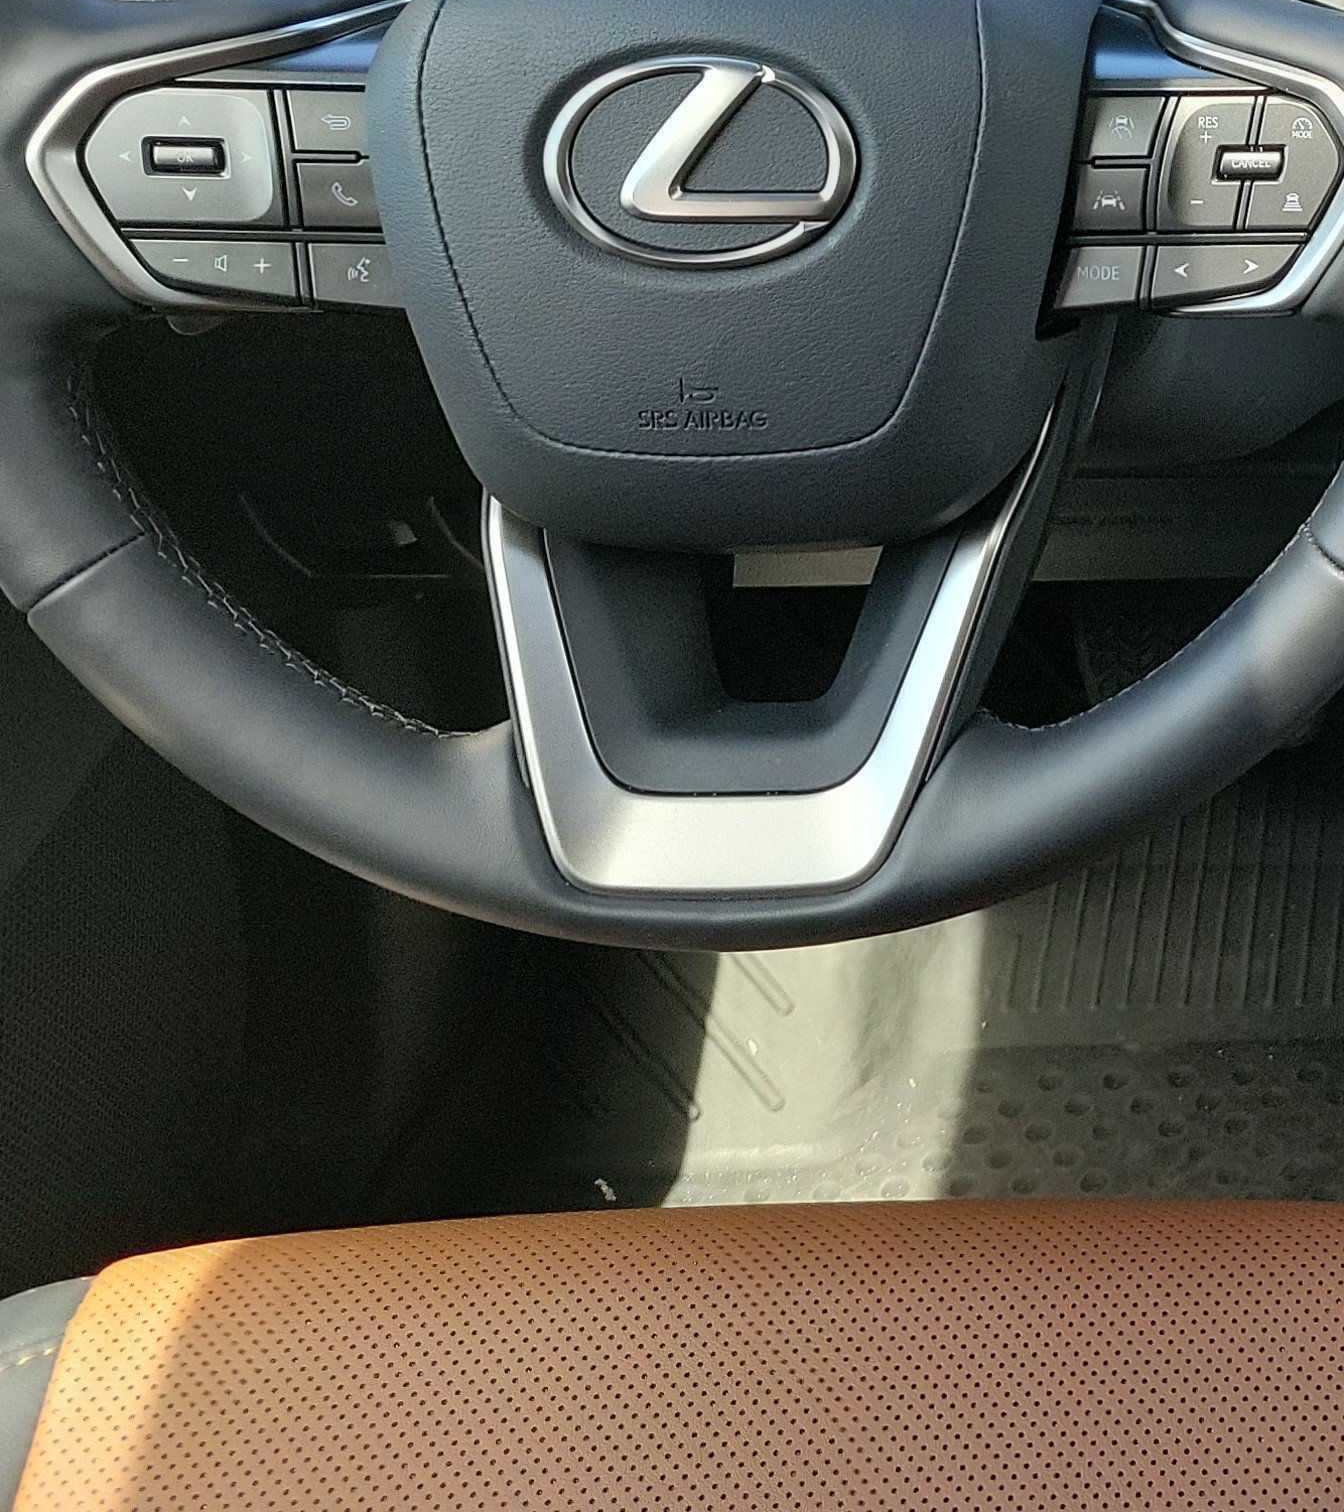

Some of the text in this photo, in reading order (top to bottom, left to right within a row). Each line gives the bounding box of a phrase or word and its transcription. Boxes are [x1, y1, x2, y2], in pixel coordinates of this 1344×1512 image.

[1197, 116, 1219, 128] RES
[1291, 130, 1313, 139] MODE
[1231, 159, 1272, 169] CANCEL
[1077, 265, 1119, 281] MODE
[637, 409, 768, 431] SRS AIRBAG
